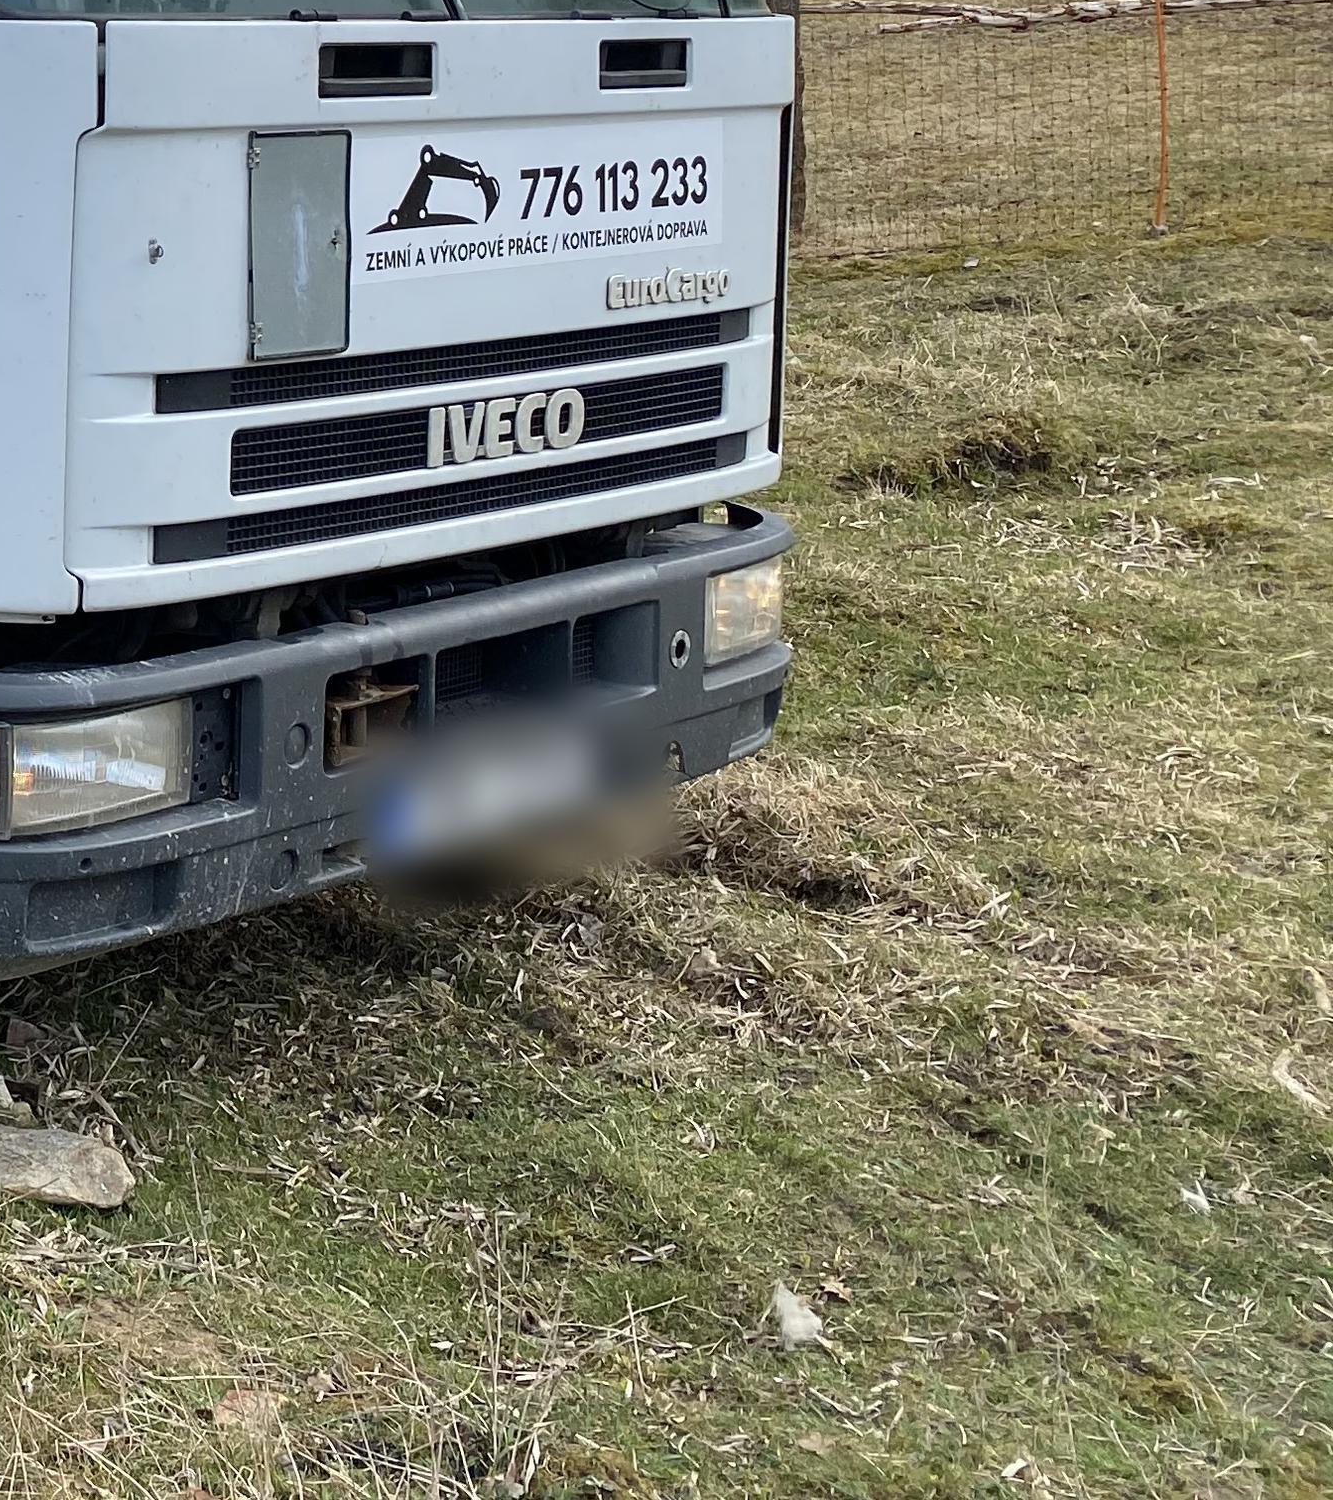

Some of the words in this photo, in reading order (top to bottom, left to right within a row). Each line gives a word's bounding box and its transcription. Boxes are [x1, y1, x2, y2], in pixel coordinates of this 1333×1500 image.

[520, 166, 583, 220] 776
[595, 161, 639, 212] 113
[650, 155, 708, 208] 233
[366, 242, 411, 271] ZEMNÍ
[415, 248, 426, 266] A
[429, 233, 504, 264] VÝKOPOVÉ
[508, 231, 548, 256] PRÁCE
[562, 219, 654, 251] KONTEJNEROVÁ
[657, 219, 708, 241] DOPRAVA
[606, 266, 731, 310] EuroCargo
[427, 388, 585, 468] IVECO
